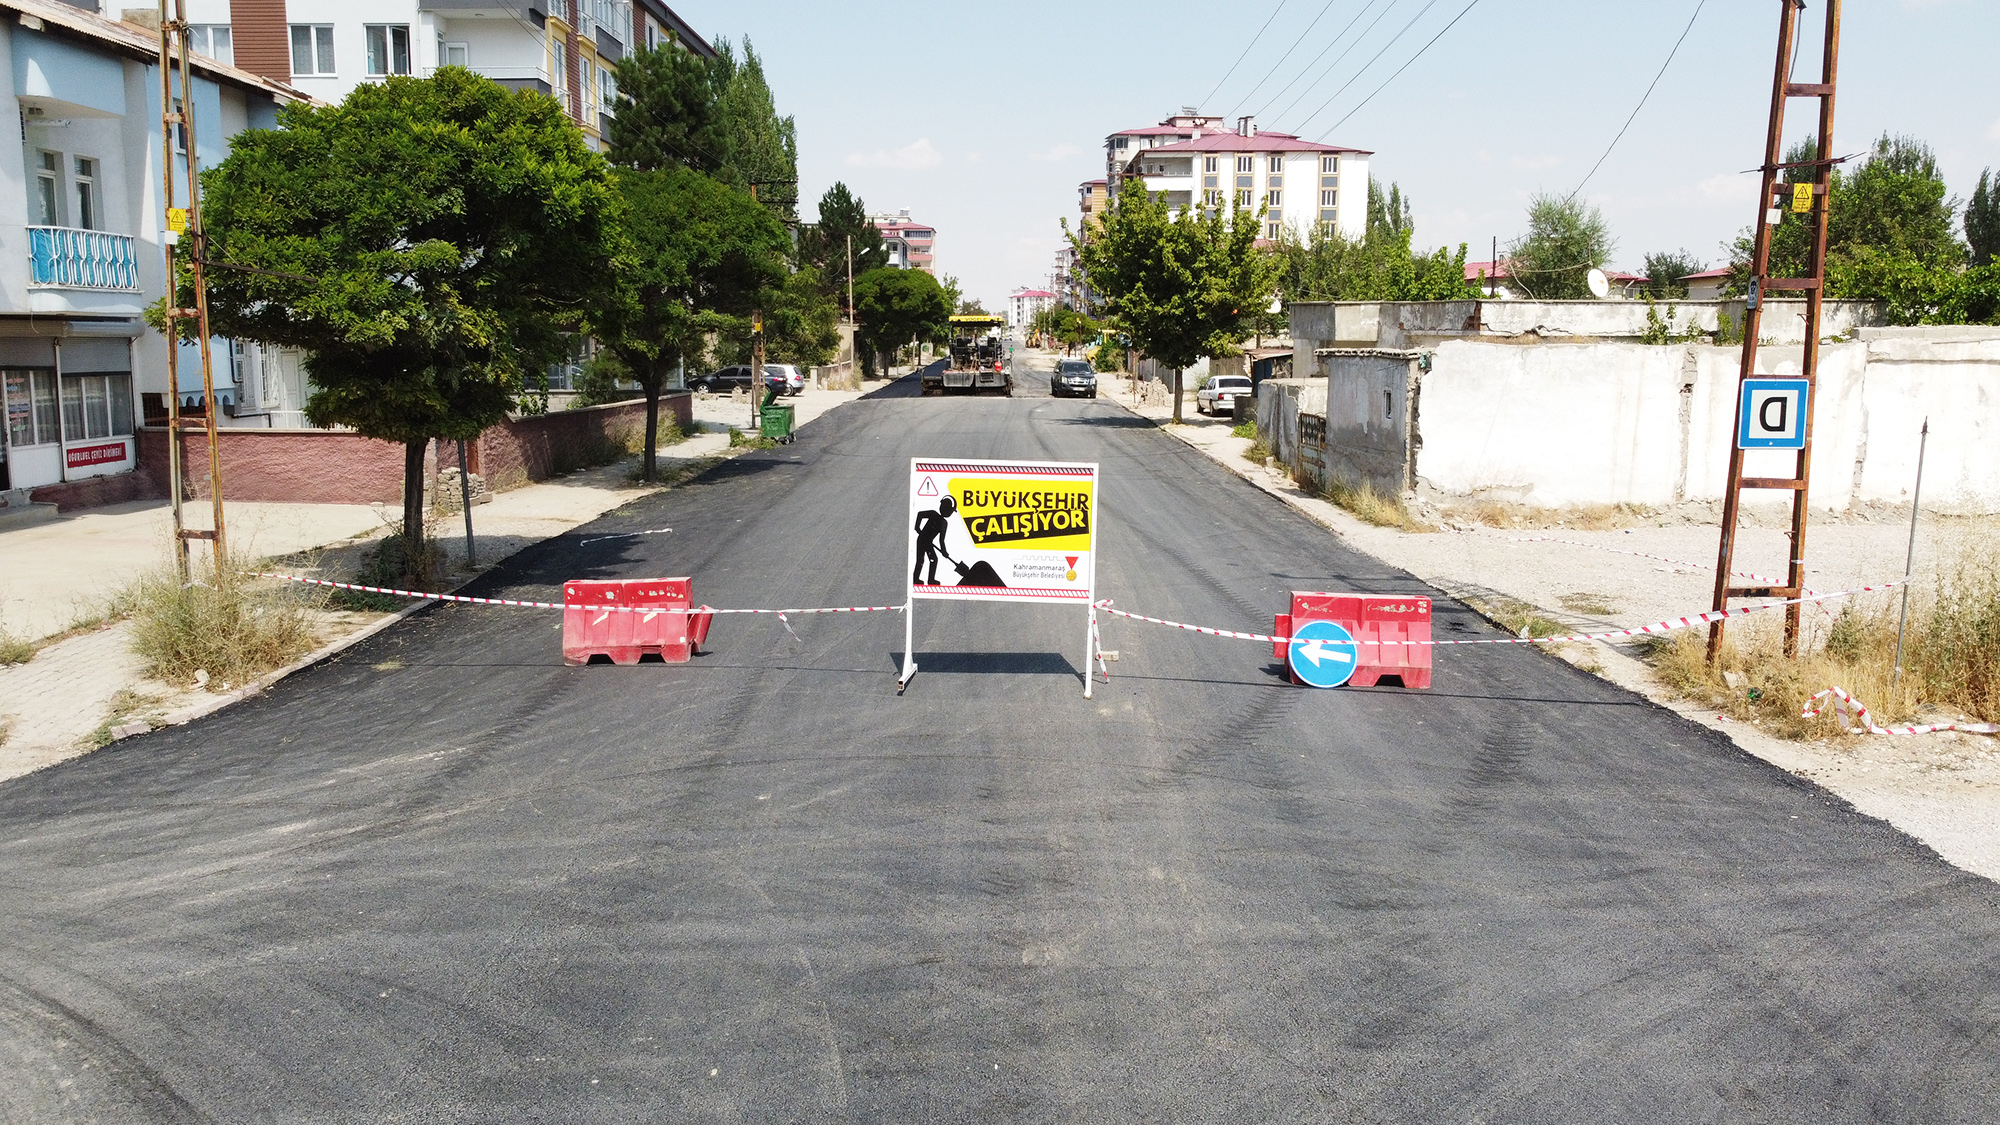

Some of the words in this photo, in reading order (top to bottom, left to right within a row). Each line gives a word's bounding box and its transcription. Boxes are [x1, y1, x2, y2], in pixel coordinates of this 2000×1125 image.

[963, 490, 1089, 514] BÜYÜKŞEHİR
[971, 510, 1086, 542] ÇALIŞIYOR
[1013, 563, 1065, 572] Kahramanmaraş
[1013, 571, 1040, 579] Büyükşehir
